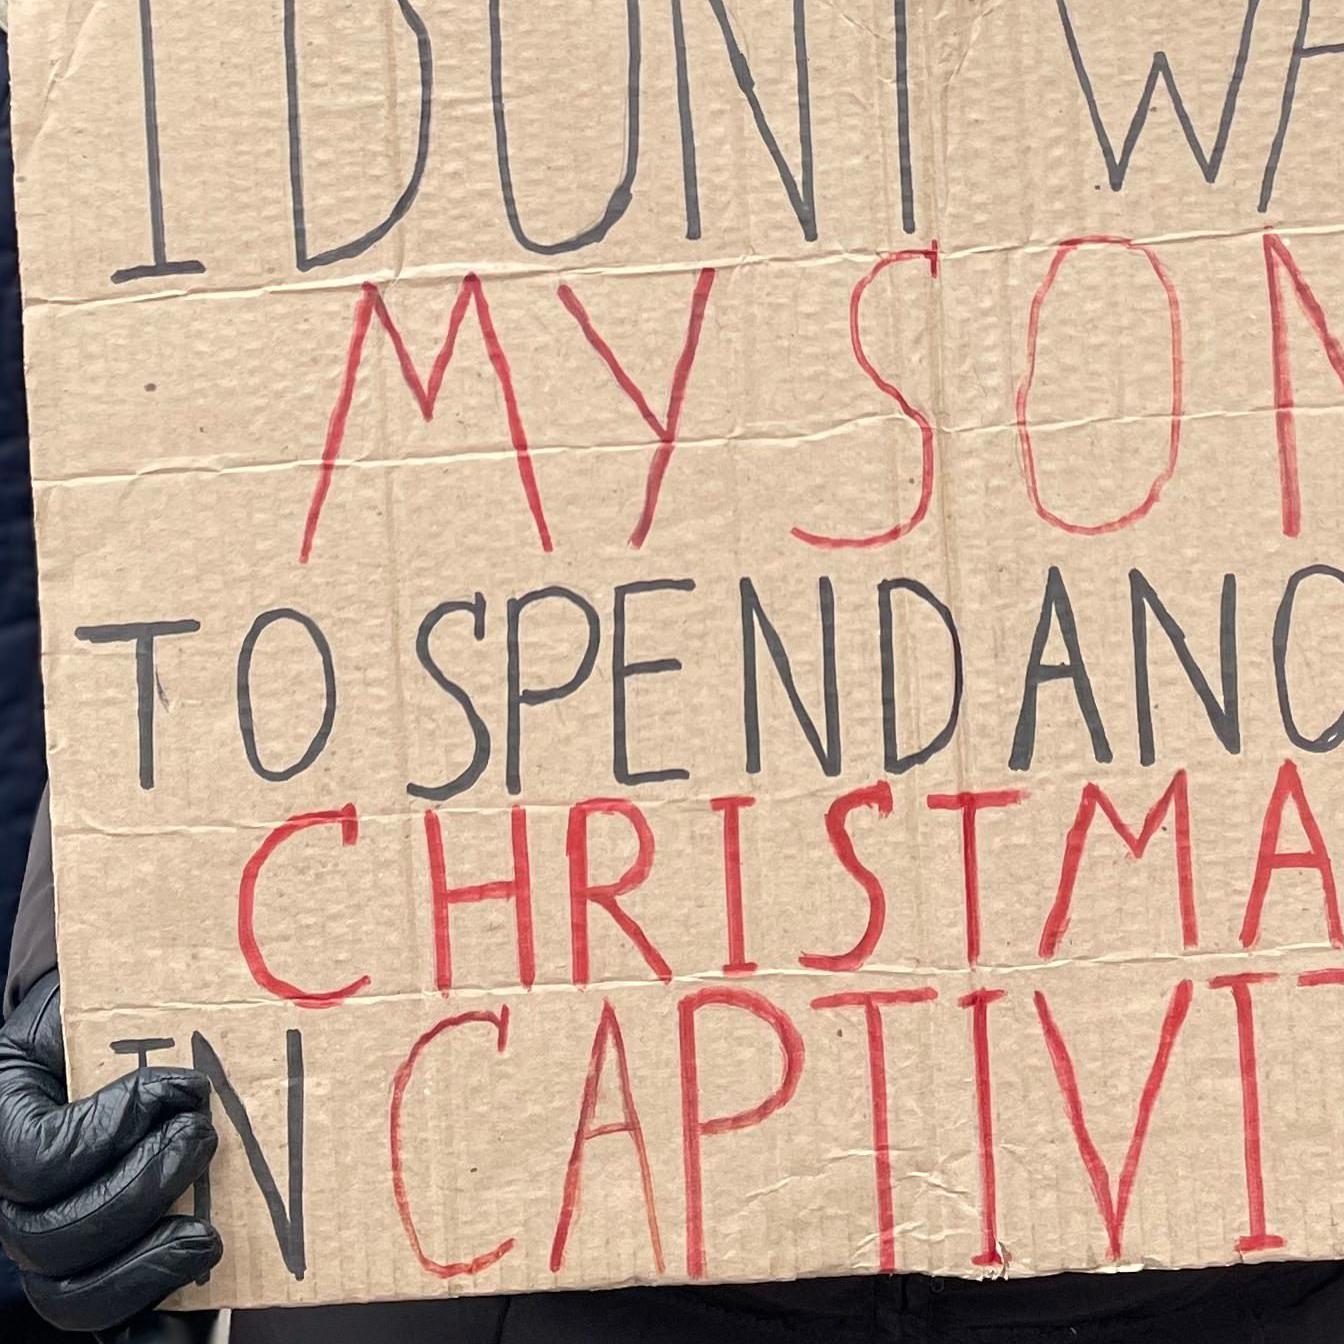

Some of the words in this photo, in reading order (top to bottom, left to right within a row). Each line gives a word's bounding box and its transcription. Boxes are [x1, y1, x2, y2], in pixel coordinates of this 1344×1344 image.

[297, 267, 716, 564] MY
[75, 607, 337, 791] TO
[406, 576, 964, 804] SPEND
[112, 1030, 306, 1284] N
